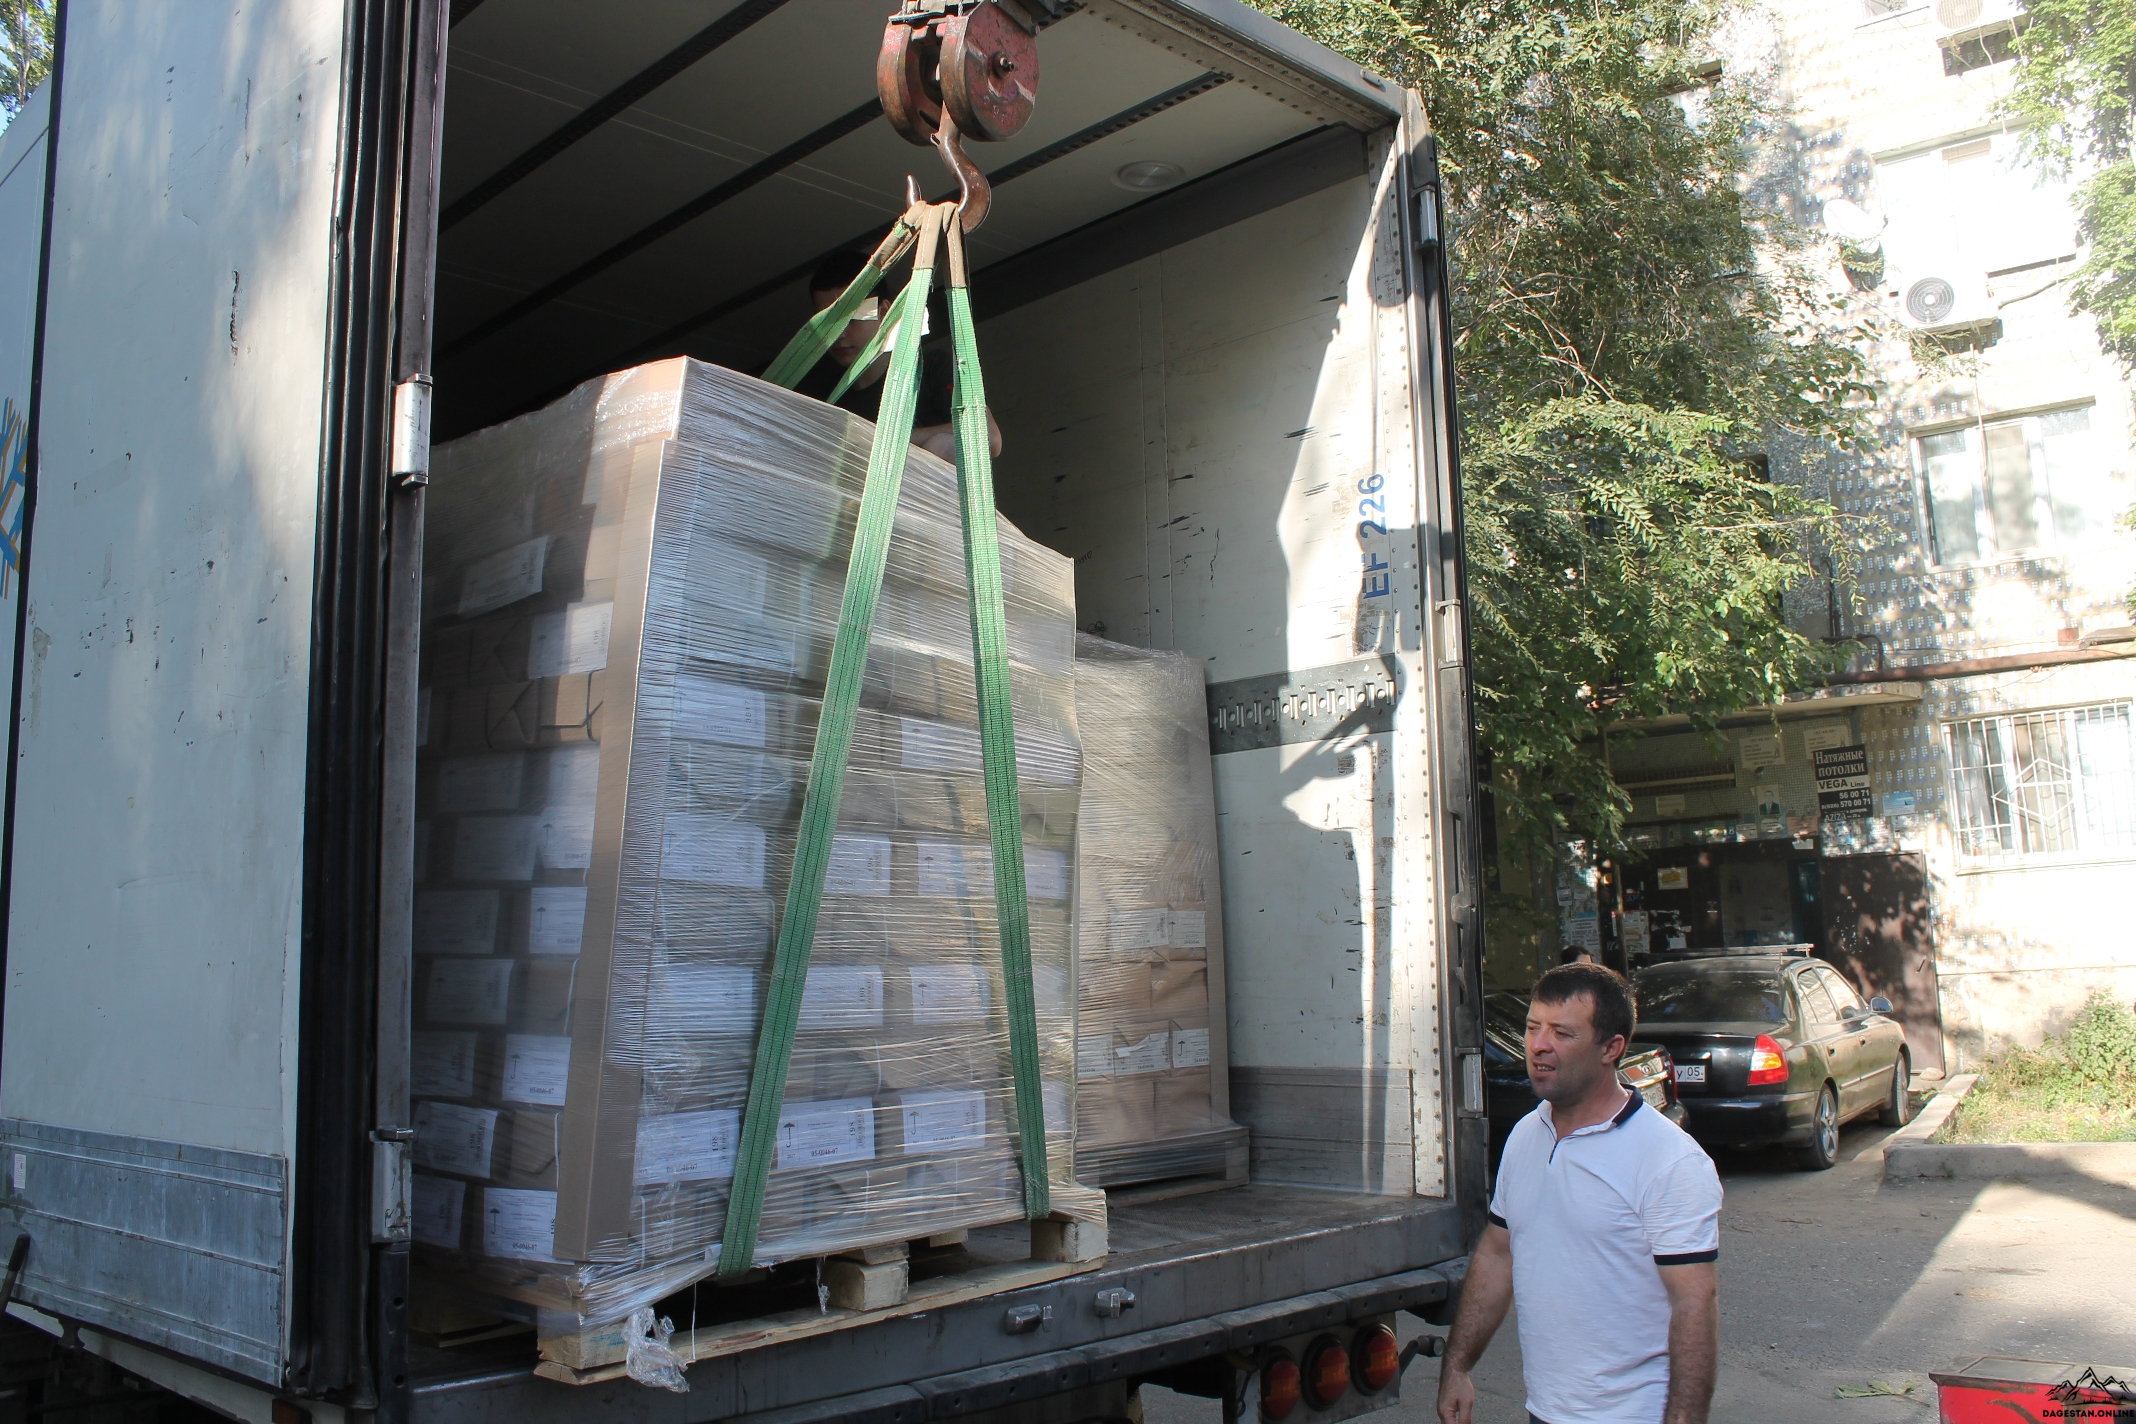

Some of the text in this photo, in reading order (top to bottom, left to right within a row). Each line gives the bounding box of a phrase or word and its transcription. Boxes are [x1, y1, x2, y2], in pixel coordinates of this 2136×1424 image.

[1357, 473, 1390, 599] EF 226
[1815, 750, 1864, 764] Натяжные
[1818, 778, 1848, 790] VEGA
[1839, 789, 1870, 799] 56 00 71
[1840, 800, 1852, 808] 570
[1853, 798, 1862, 806] 00
[1862, 797, 1871, 805] 71
[1687, 1066, 1700, 1077] 05
